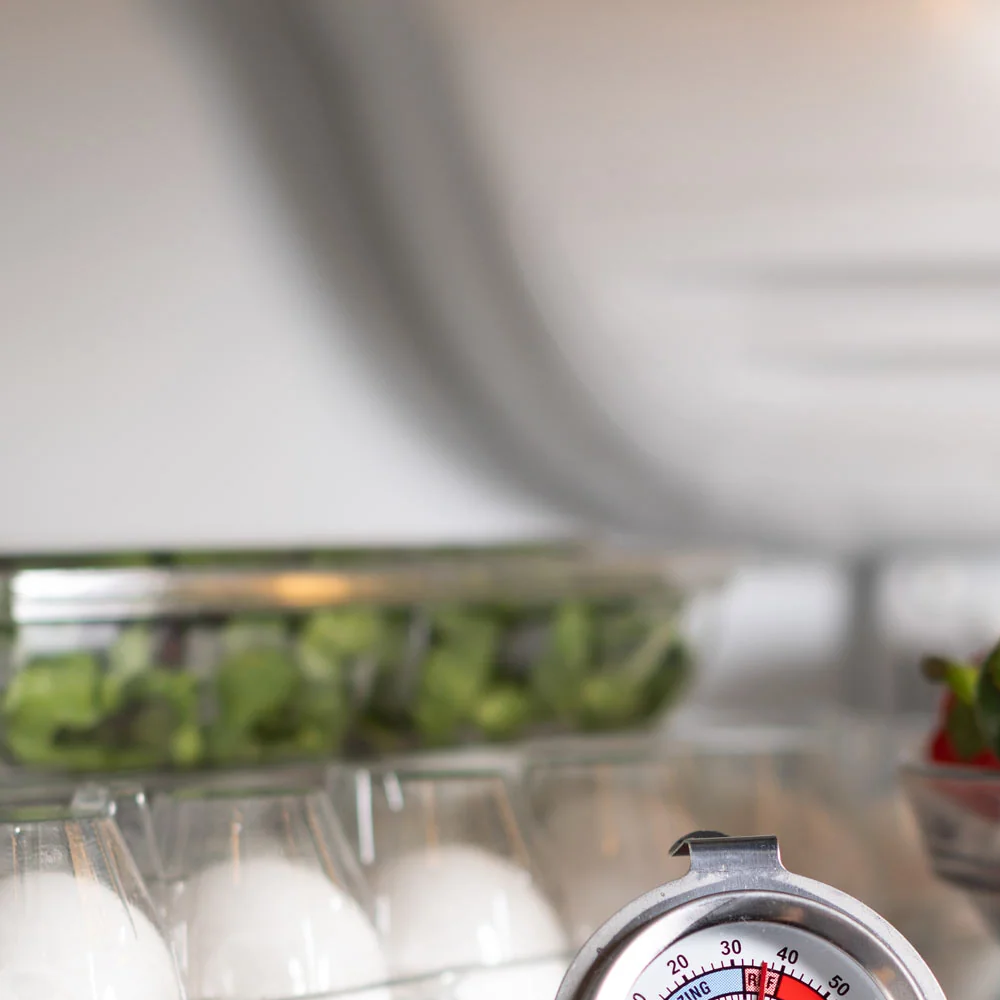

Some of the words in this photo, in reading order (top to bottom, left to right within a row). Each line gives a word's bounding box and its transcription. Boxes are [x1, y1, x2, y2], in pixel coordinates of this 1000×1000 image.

[720, 939, 742, 956] 30
[776, 946, 799, 965] 40
[666, 954, 689, 975] 20
[747, 973, 776, 989] RF
[828, 974, 850, 997] 50
